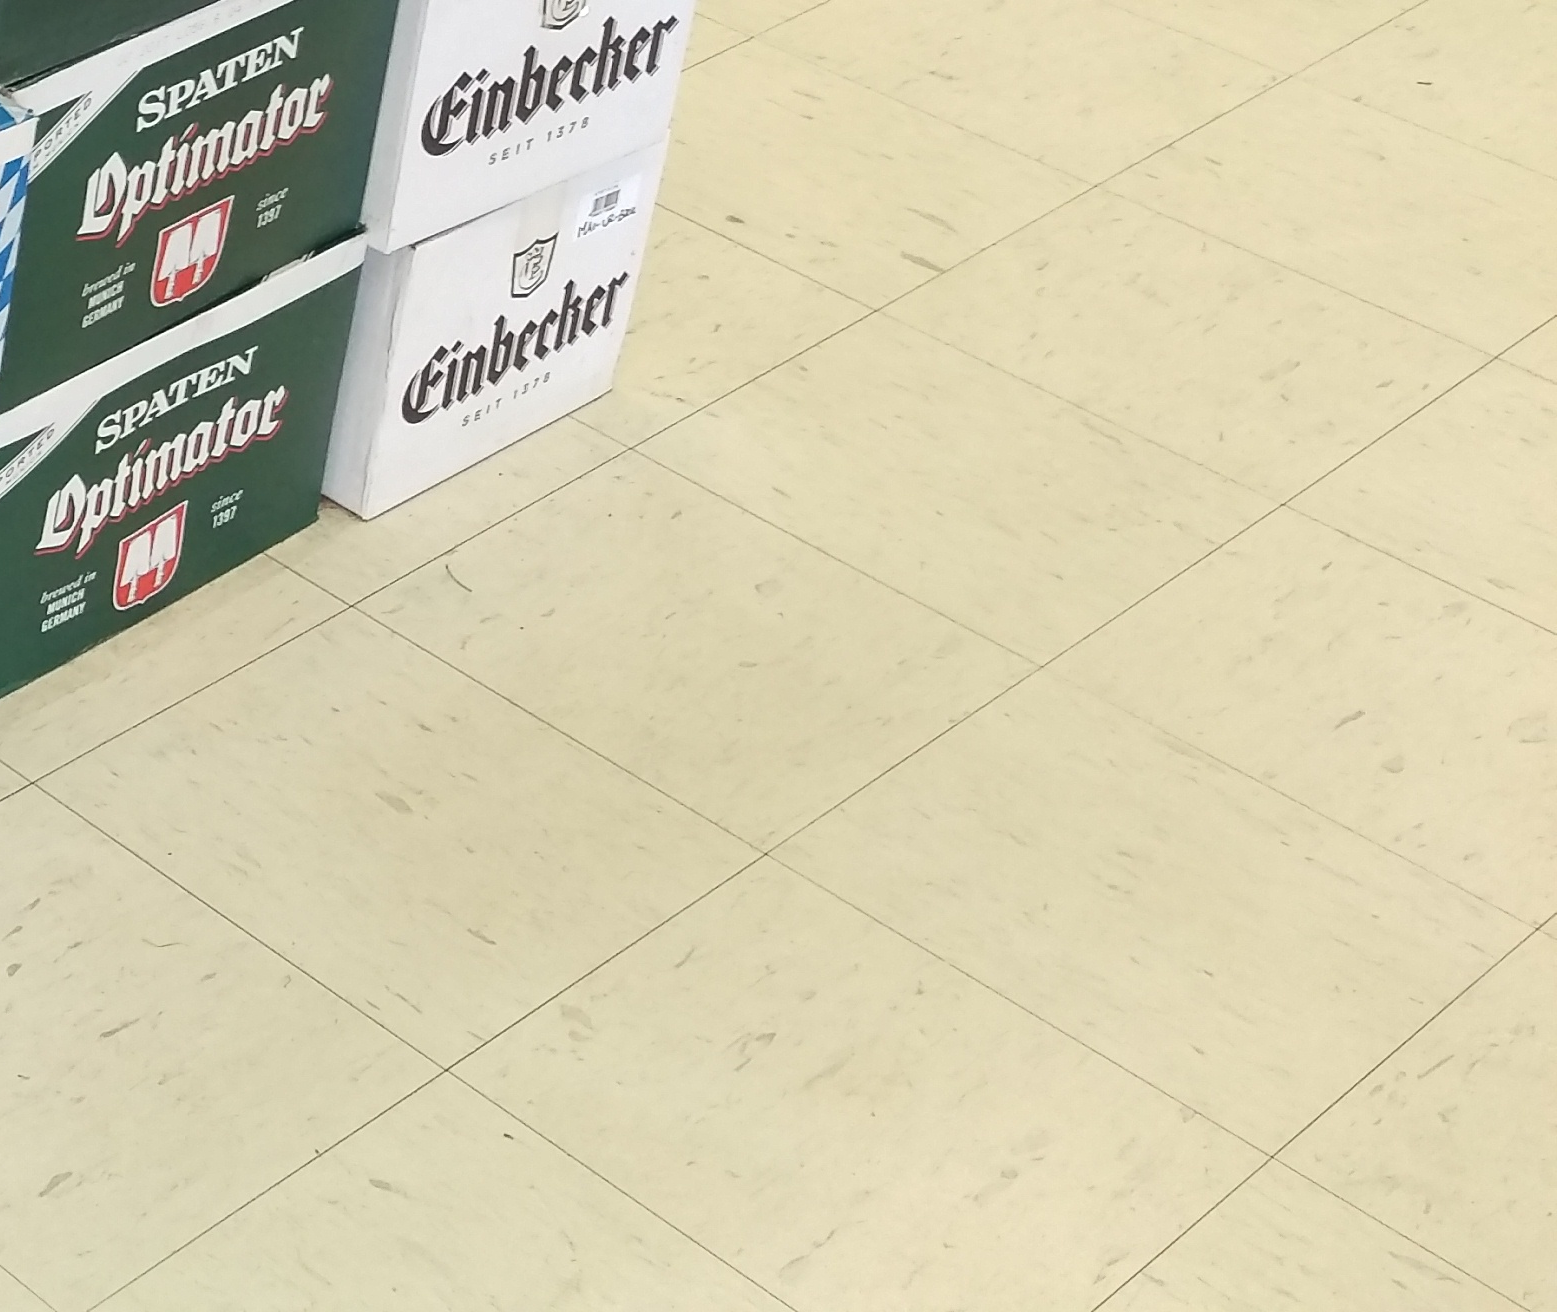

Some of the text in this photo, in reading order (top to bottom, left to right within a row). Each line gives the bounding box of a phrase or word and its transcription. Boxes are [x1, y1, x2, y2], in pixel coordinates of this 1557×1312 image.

[136, 26, 304, 133] SPATEN
[421, 14, 680, 157] Einbecker
[487, 116, 591, 166] SEIT 1378
[76, 73, 334, 248] Optimator
[256, 187, 289, 211] since
[256, 207, 281, 229] 1397
[87, 280, 124, 309] MUNICH
[82, 297, 125, 329] GERMANY
[401, 272, 630, 425] Einbecker
[95, 346, 258, 455] SPATEN
[461, 371, 552, 428] SEIT 1378
[34, 385, 287, 558] Optimator
[210, 490, 243, 513] since
[212, 506, 237, 529] 1397
[39, 577, 82, 604] brewed
[46, 588, 85, 616] MUNICH
[41, 602, 85, 633] GERMANY
